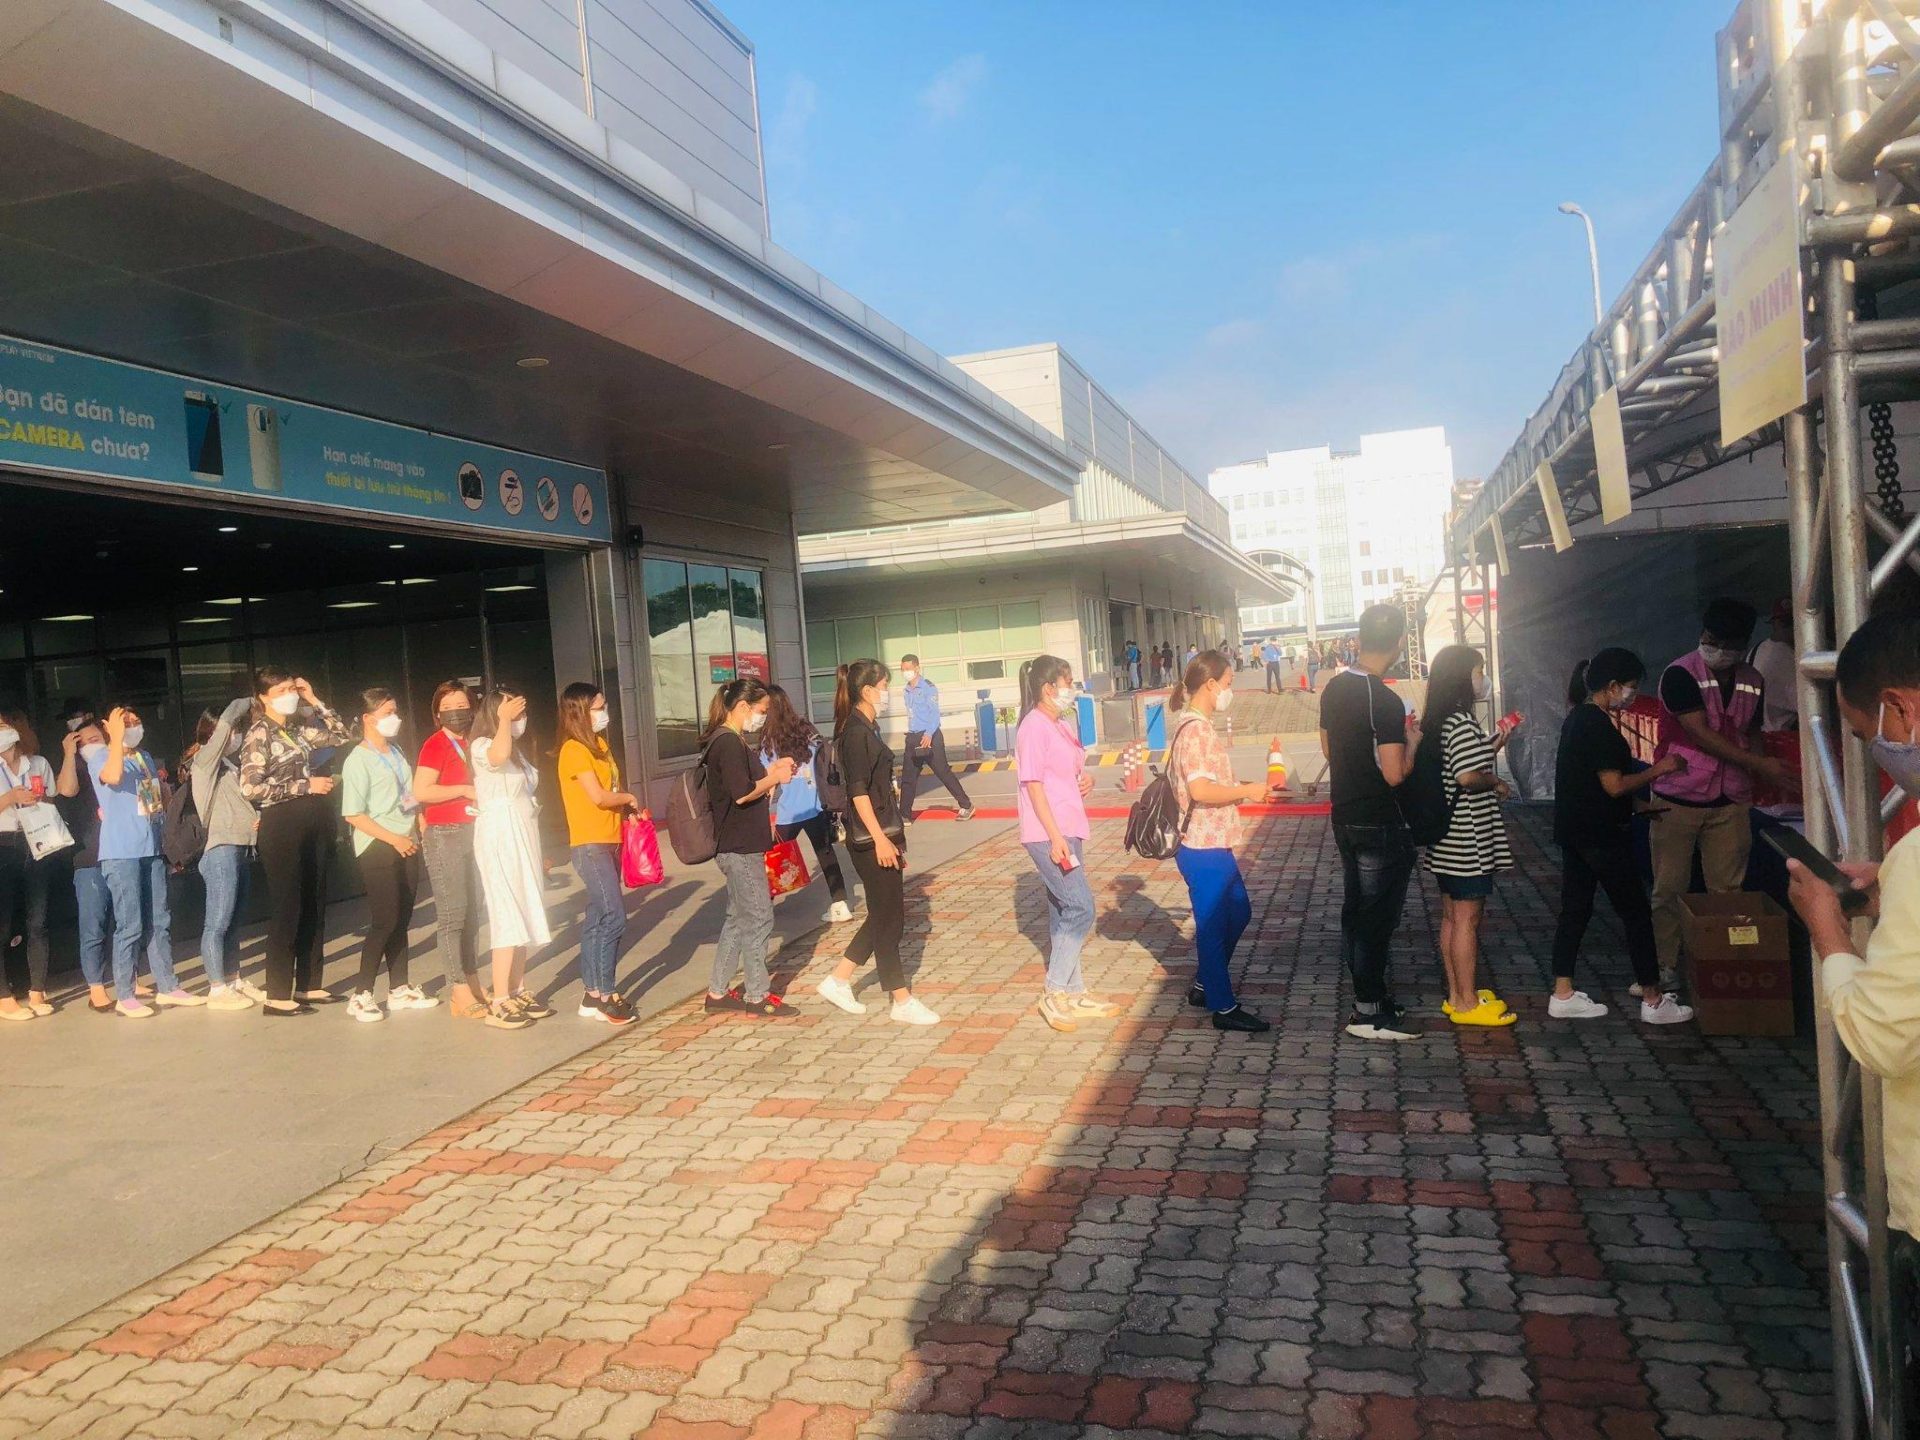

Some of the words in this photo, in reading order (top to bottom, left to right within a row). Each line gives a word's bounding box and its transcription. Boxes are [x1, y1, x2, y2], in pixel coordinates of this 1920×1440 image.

[1750, 265, 1794, 339] MINH
[40, 392, 69, 415] đã
[75, 399, 113, 422] dán
[118, 406, 156, 430] tem
[0, 418, 84, 452] CAMERA
[91, 436, 150, 461] chưa?
[323, 446, 347, 466] Hạn
[350, 451, 371, 467] chế
[373, 458, 404, 477] mang
[407, 462, 425, 478] vào
